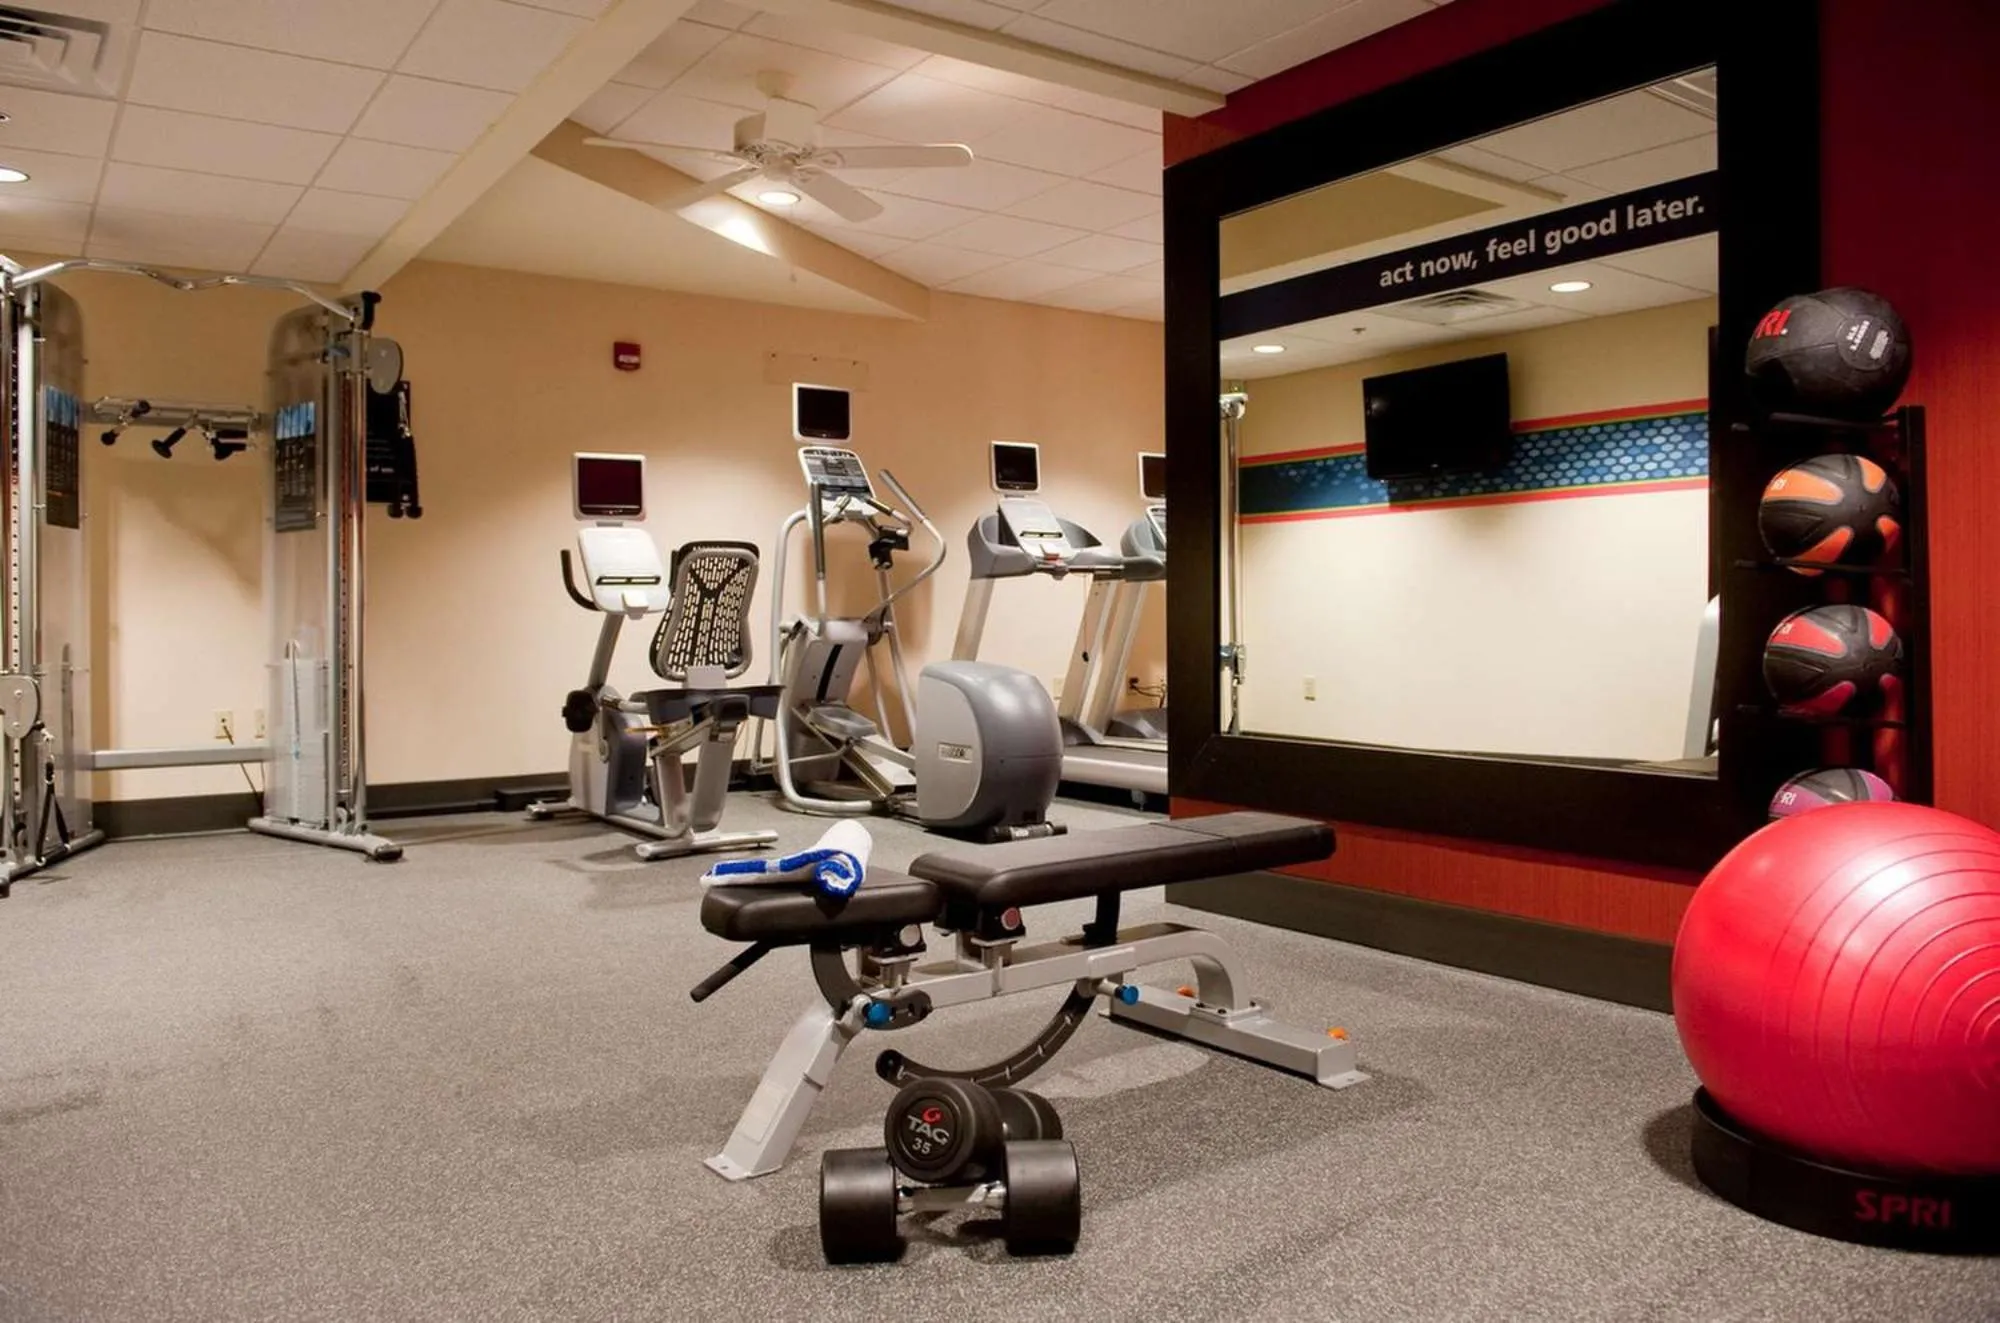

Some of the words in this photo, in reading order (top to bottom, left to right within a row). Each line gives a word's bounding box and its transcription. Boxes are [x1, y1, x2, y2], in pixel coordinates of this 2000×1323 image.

[1379, 265, 1414, 288] act
[1420, 249, 1479, 277] now,
[1485, 230, 1536, 263] feel
[1544, 209, 1617, 255] good
[1627, 194, 1705, 230] later.
[907, 1115, 950, 1146] TAG
[912, 1136, 933, 1155] 35
[1855, 1189, 1951, 1227] SPRI
